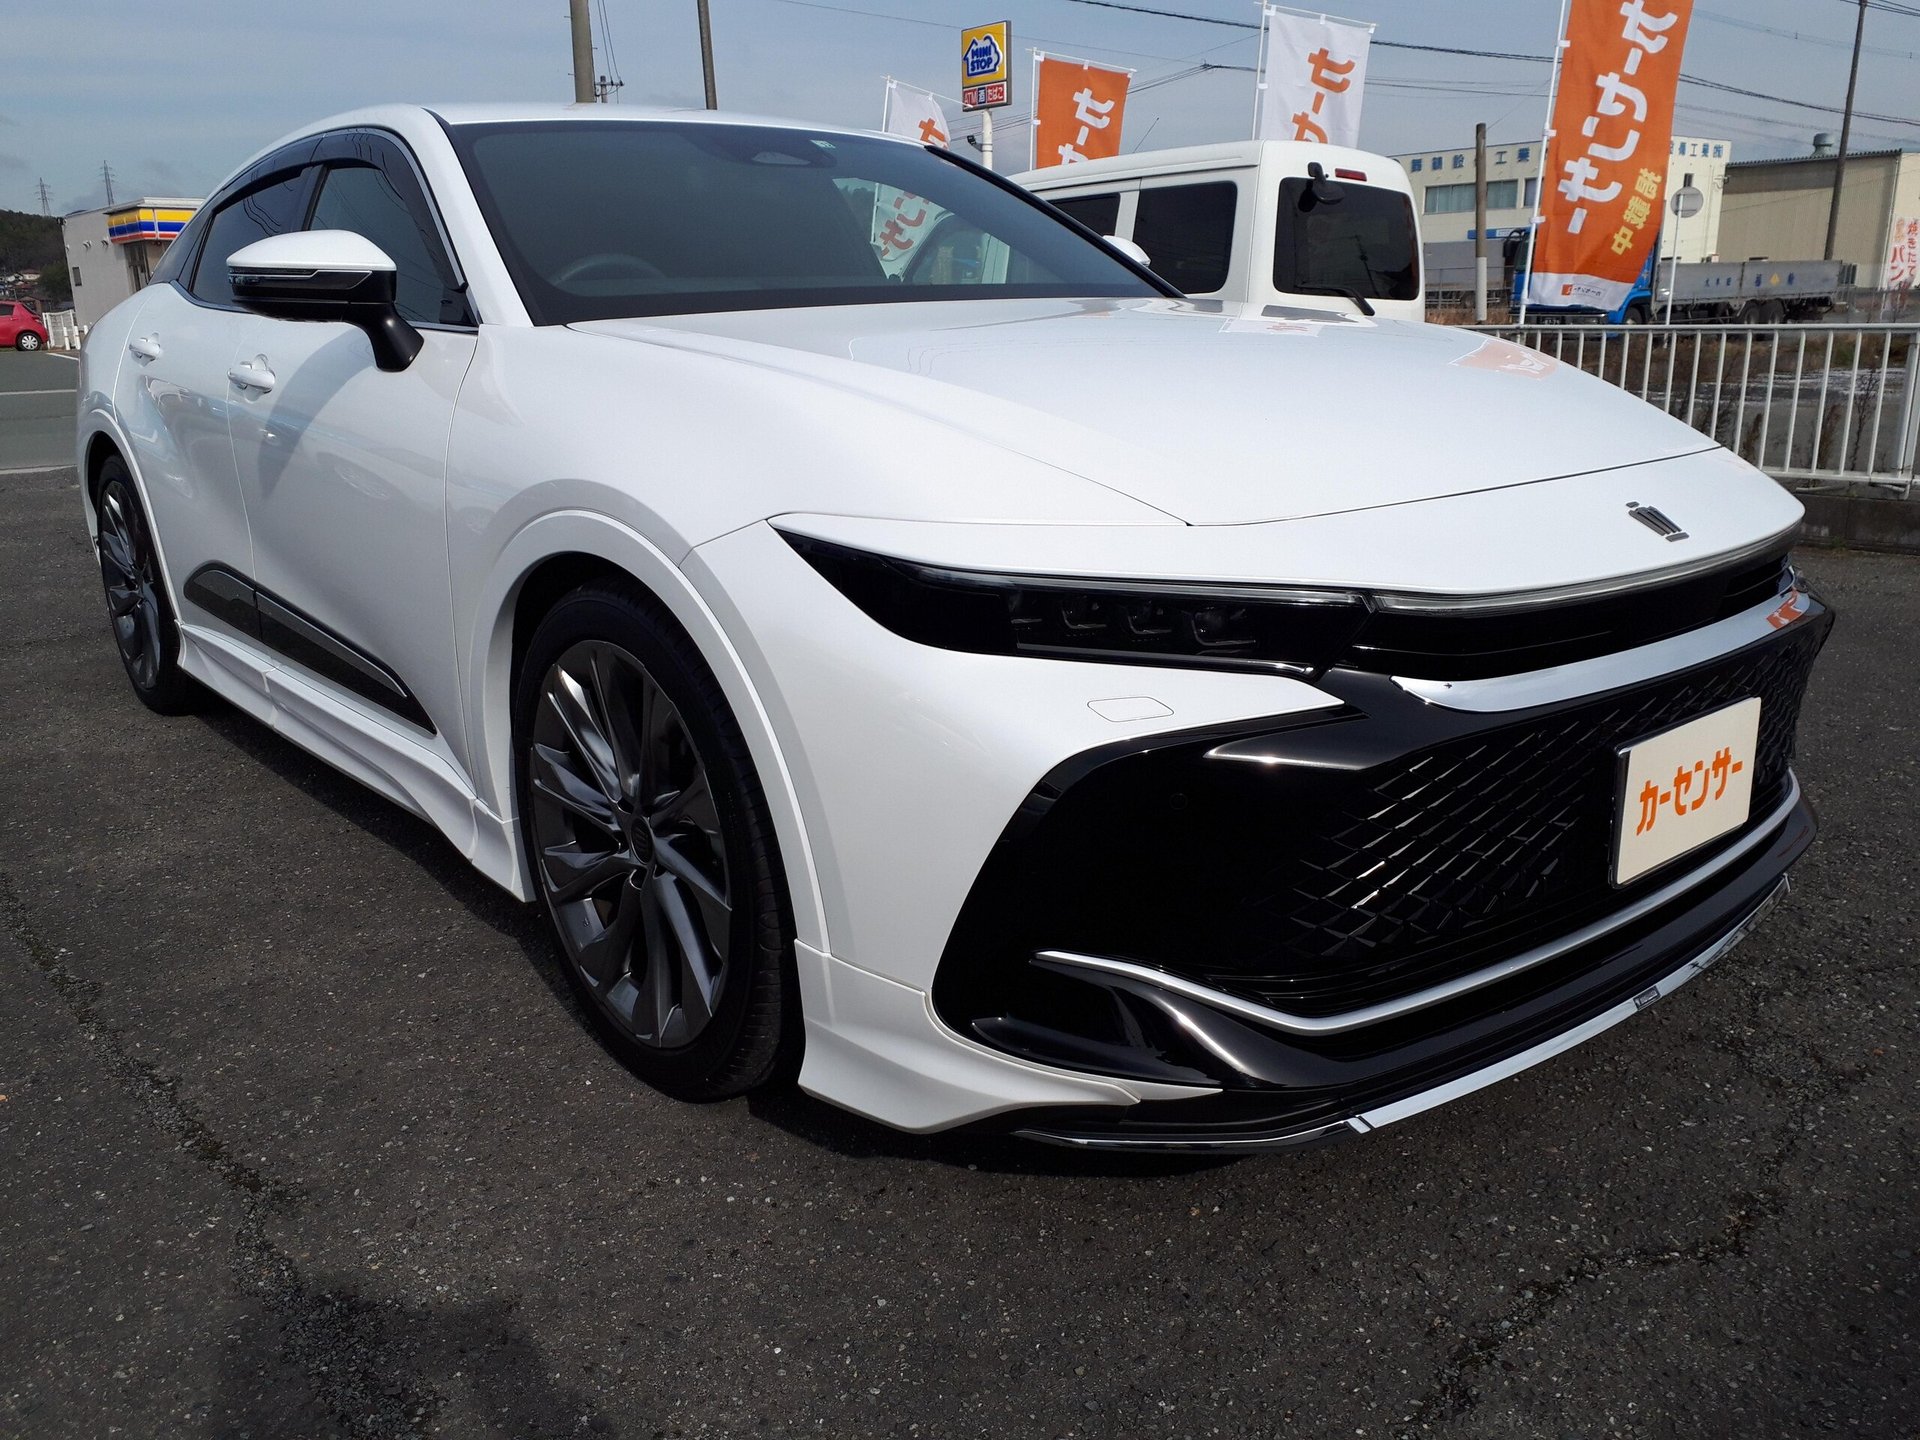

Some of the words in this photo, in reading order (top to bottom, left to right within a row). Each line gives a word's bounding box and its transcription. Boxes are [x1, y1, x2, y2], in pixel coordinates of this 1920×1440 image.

[969, 57, 993, 72] STOP
[970, 46, 992, 59] MINI
[963, 91, 978, 105] ATM
[986, 87, 1004, 102] たばこ
[1907, 218, 1918, 277] 焼きたて
[1890, 245, 1905, 281] パン
[1636, 746, 1743, 836] カーセンサー
